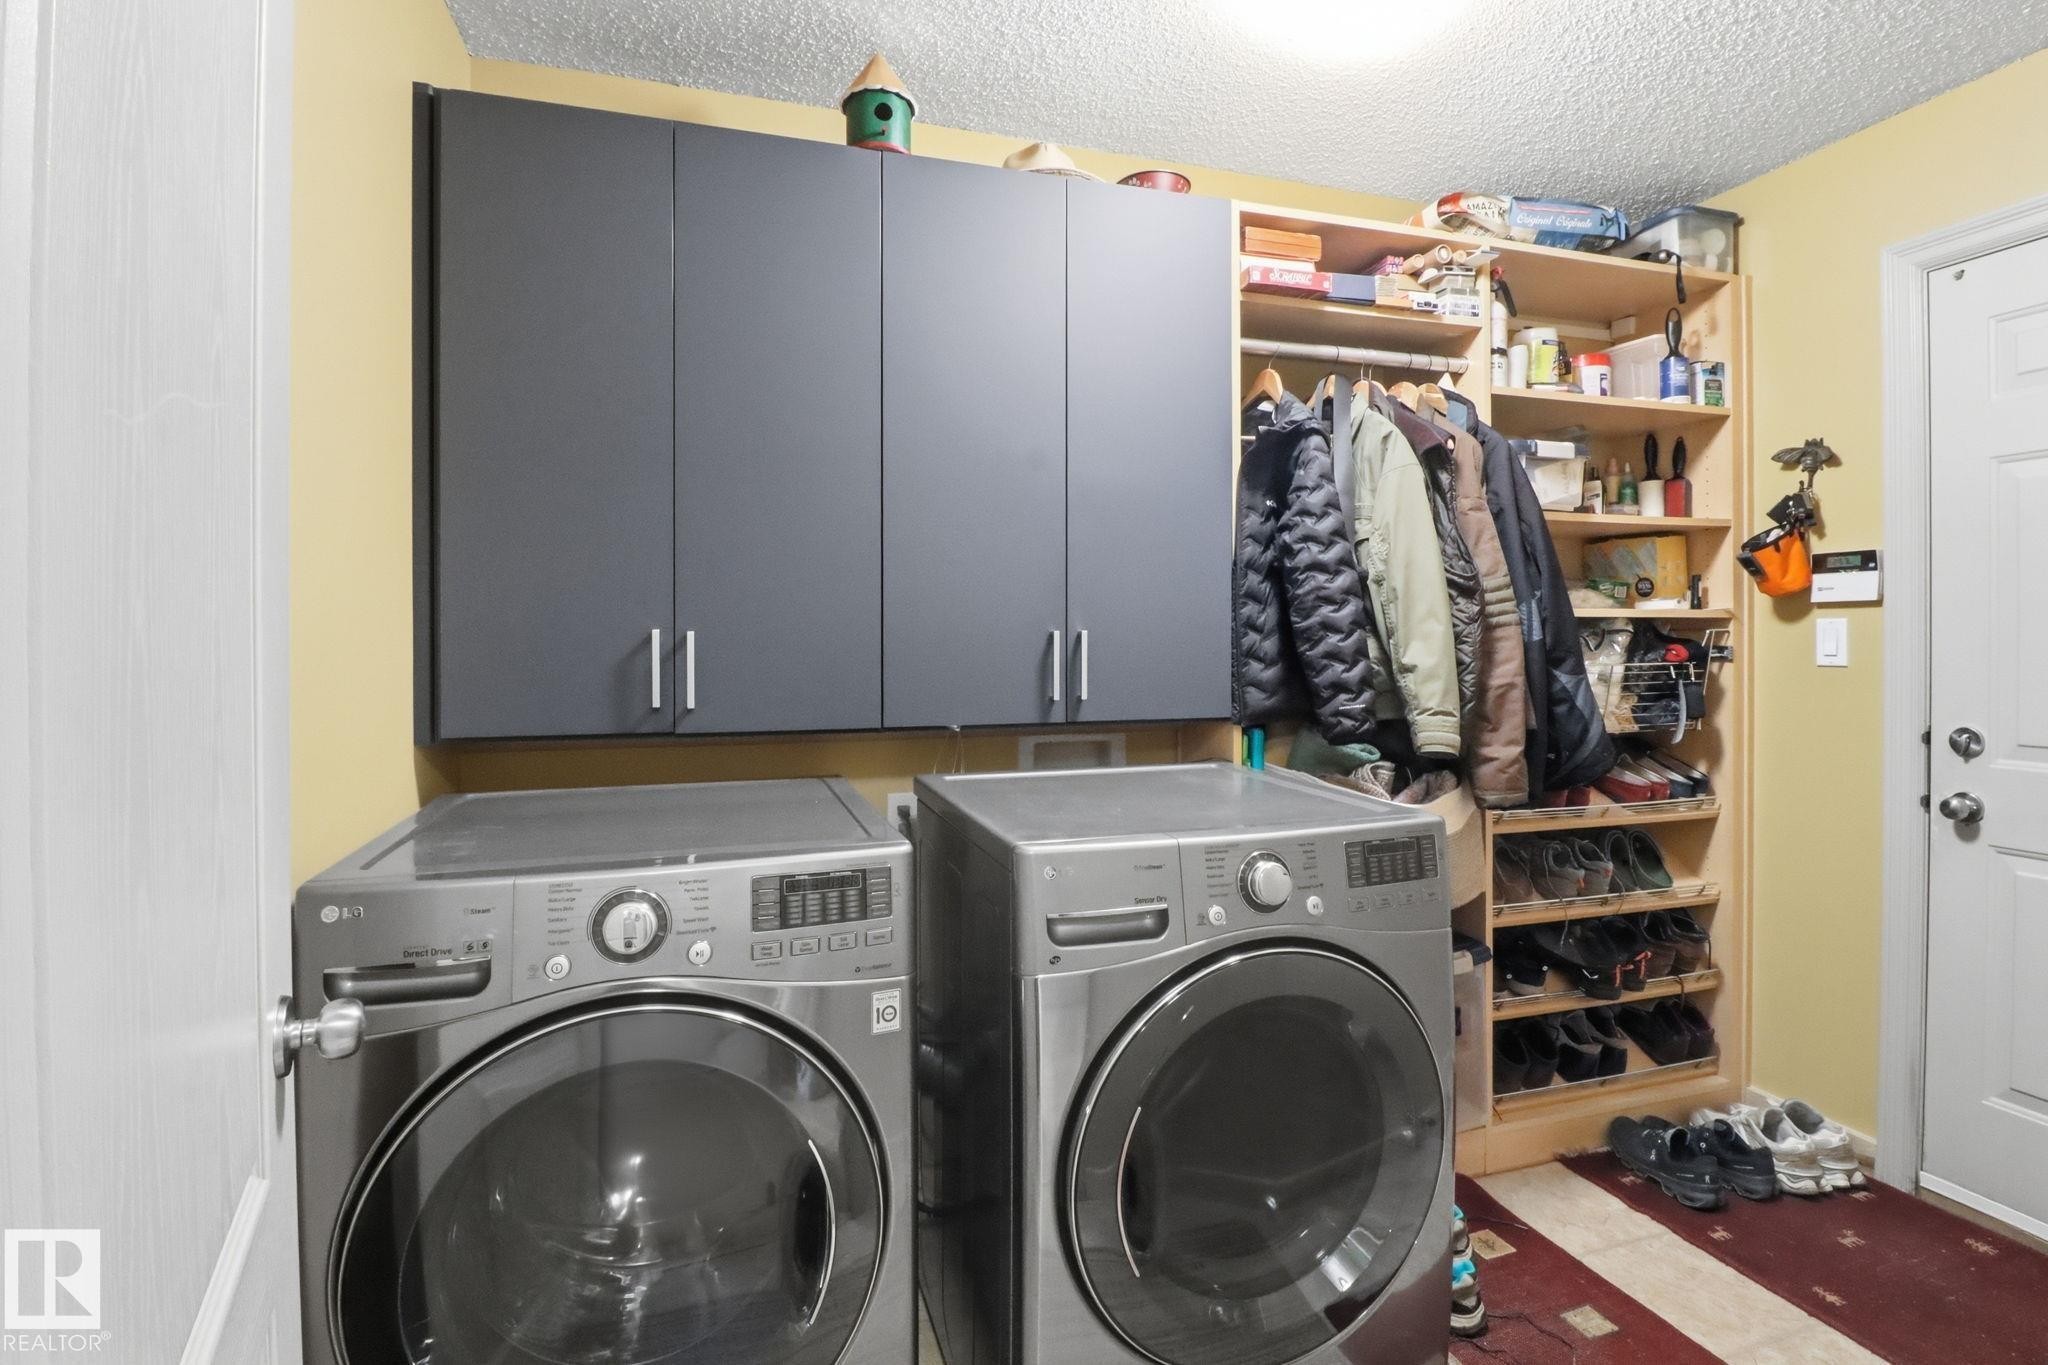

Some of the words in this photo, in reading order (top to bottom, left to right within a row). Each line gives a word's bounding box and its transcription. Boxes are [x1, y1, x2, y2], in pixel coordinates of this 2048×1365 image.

[1516, 212, 1554, 228] Original
[1156, 895, 1168, 903] Dry
[342, 906, 364, 919] LG
[402, 949, 429, 959] Direct
[430, 947, 453, 957] Drive
[876, 1004, 897, 1024] 10
